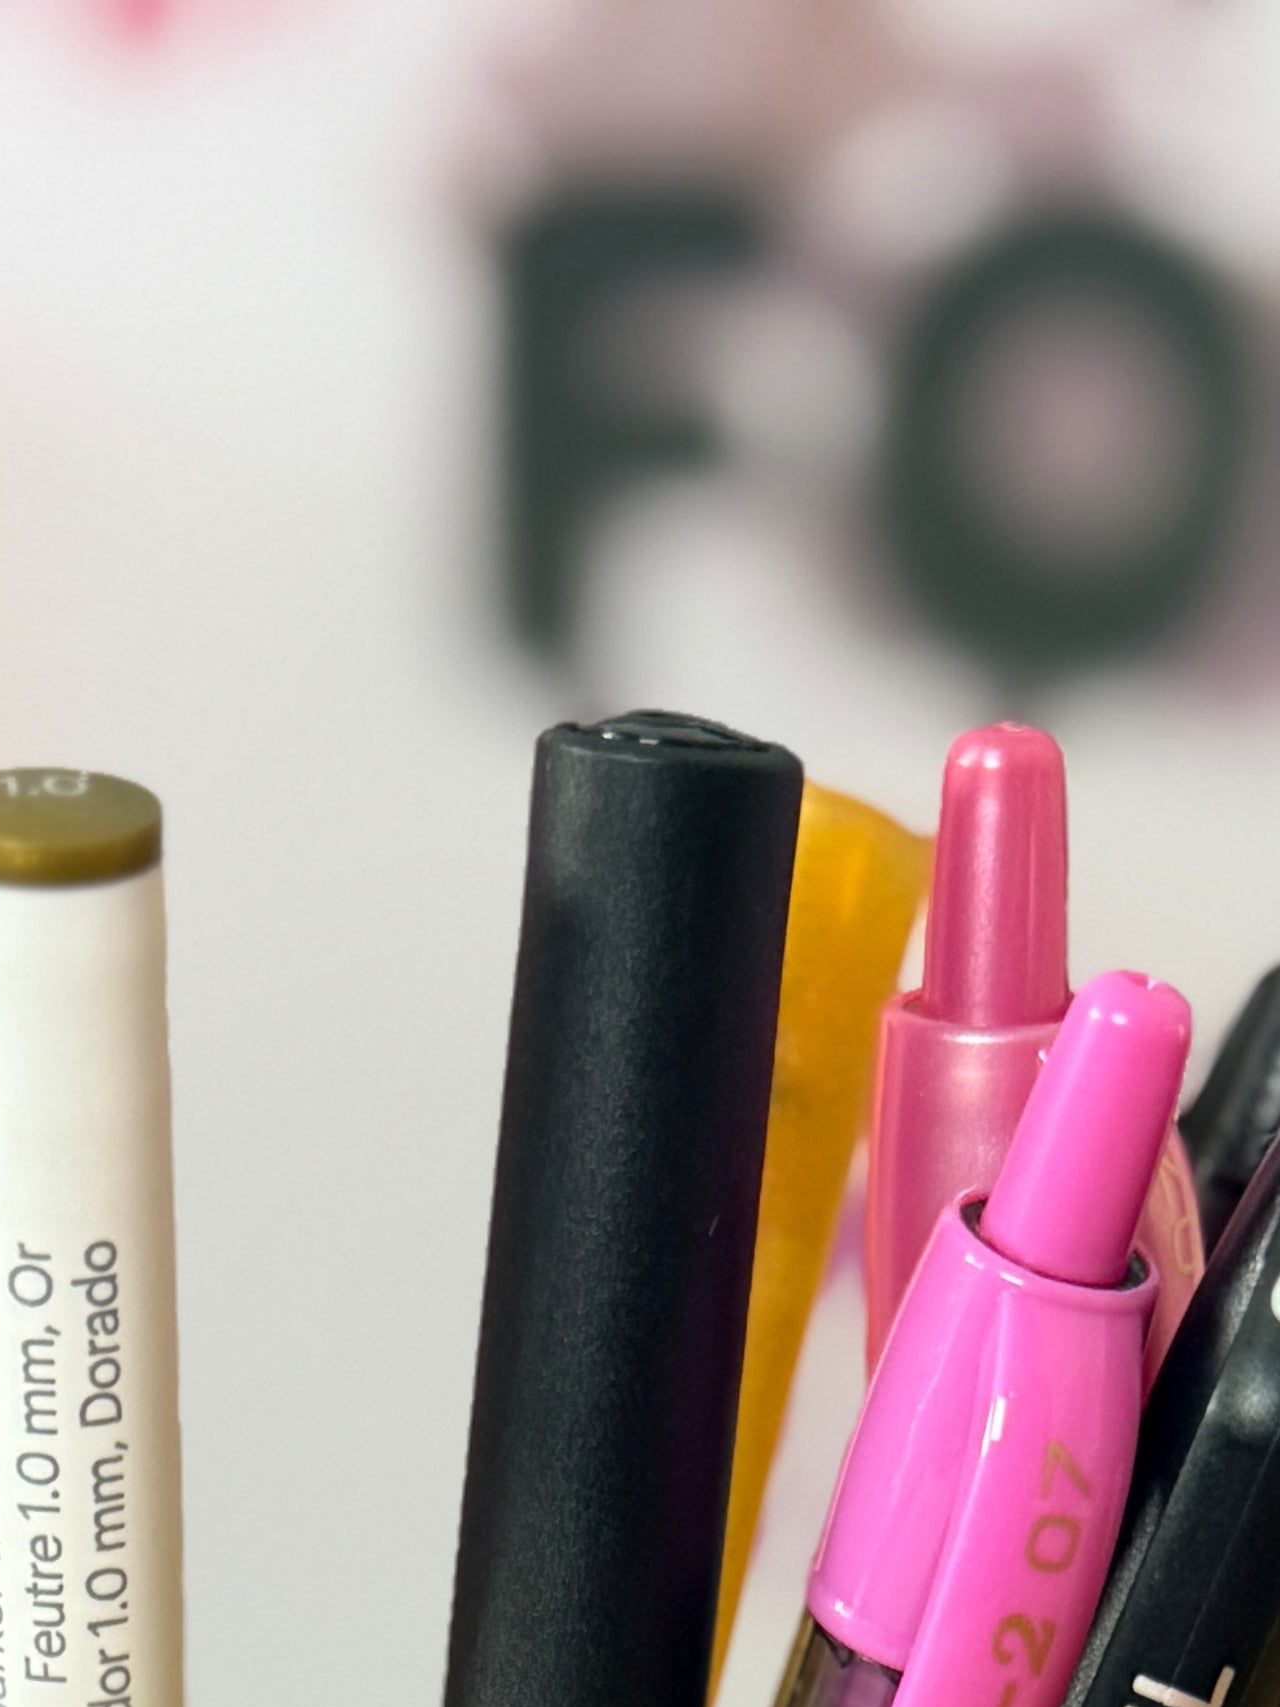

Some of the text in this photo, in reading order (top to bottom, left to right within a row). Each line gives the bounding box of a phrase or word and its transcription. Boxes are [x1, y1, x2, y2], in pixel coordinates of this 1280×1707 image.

[70, 1239, 123, 1428] Dorado
[7, 1241, 68, 1684] Feutre 1.0 mm, Or
[92, 1440, 129, 1552] mm,
[1026, 1440, 1091, 1574] 07
[85, 1567, 129, 1637] 1.0
